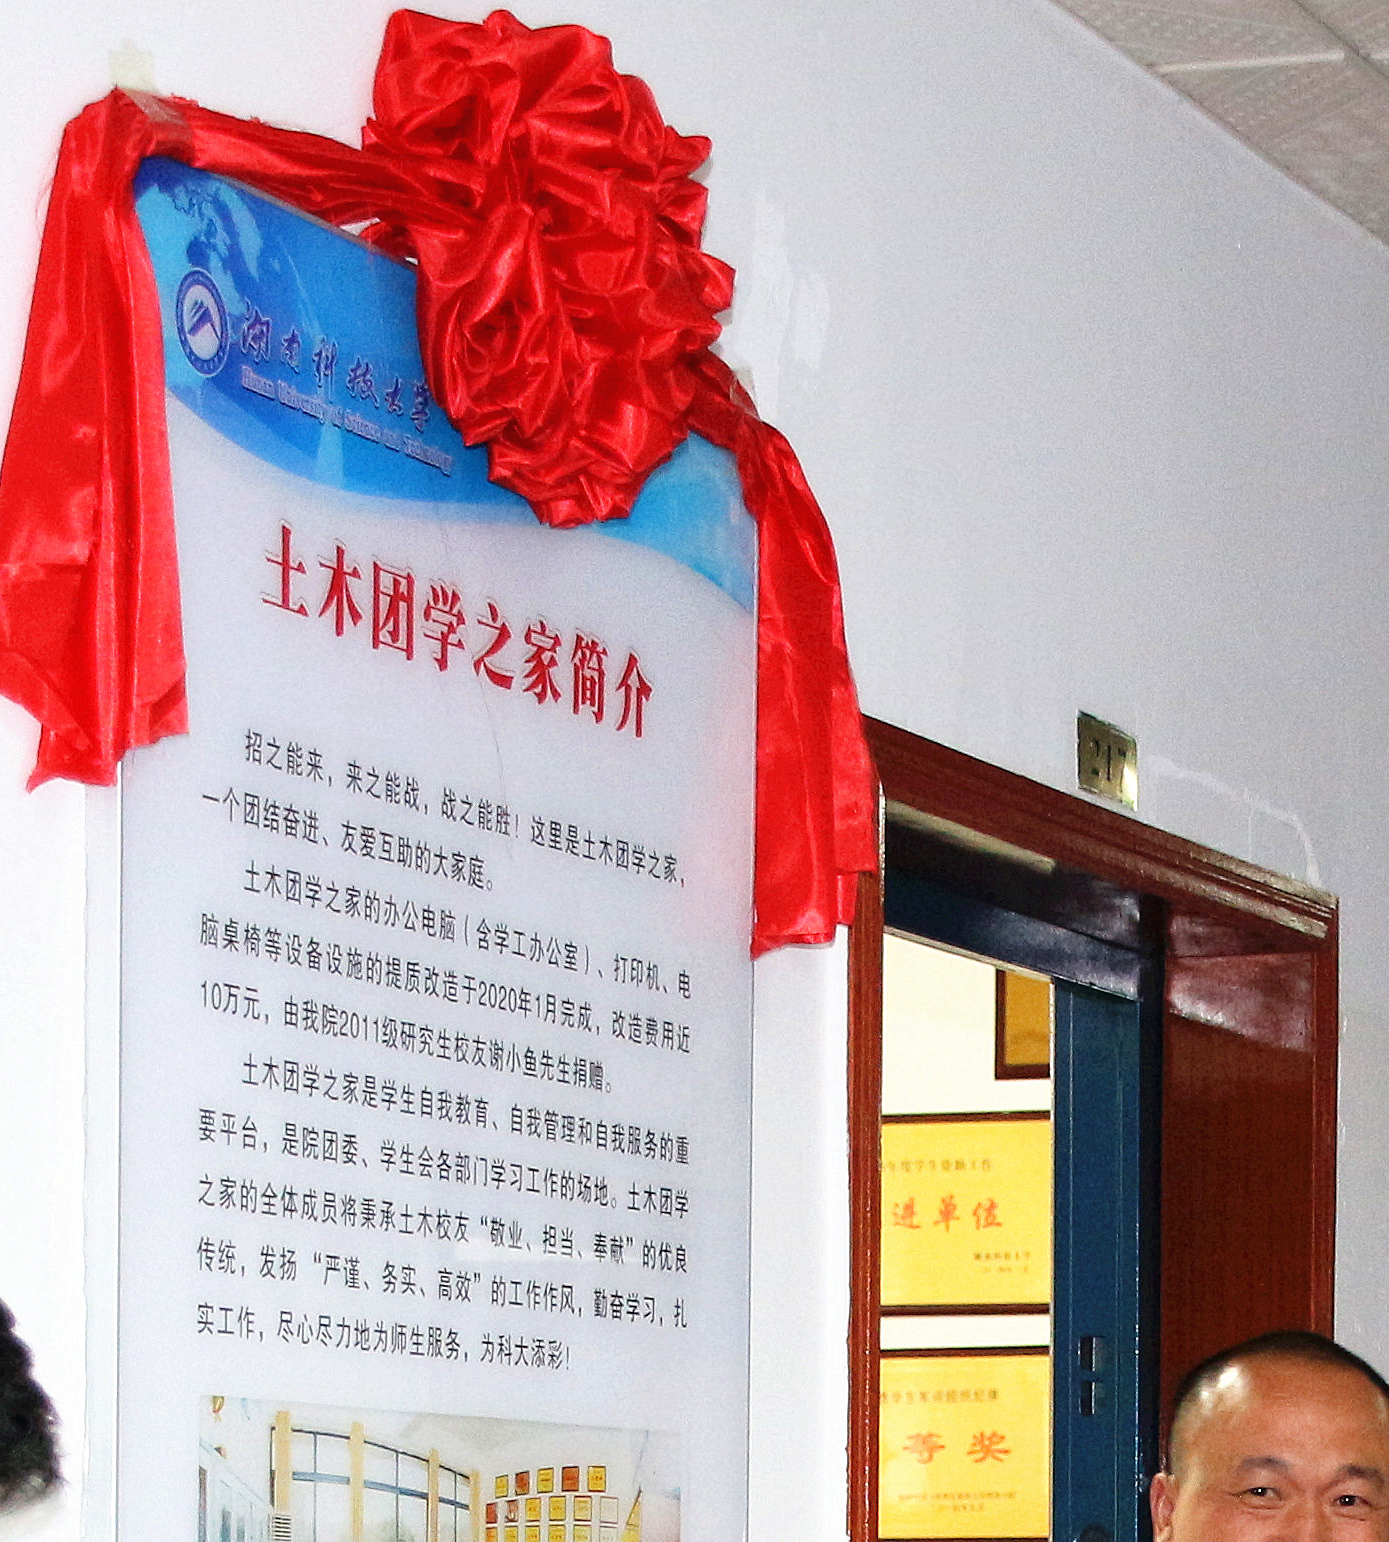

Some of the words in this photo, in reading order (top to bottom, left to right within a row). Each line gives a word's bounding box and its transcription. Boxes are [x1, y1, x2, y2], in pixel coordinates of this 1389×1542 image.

[261, 523, 653, 738] 土木团学之家简介
[202, 786, 494, 891] 一个团结奋进、友爱互助的大家庭。
[242, 1053, 689, 1165] 土木团学之家是学生自我教育、自我管理和自我服务的重
